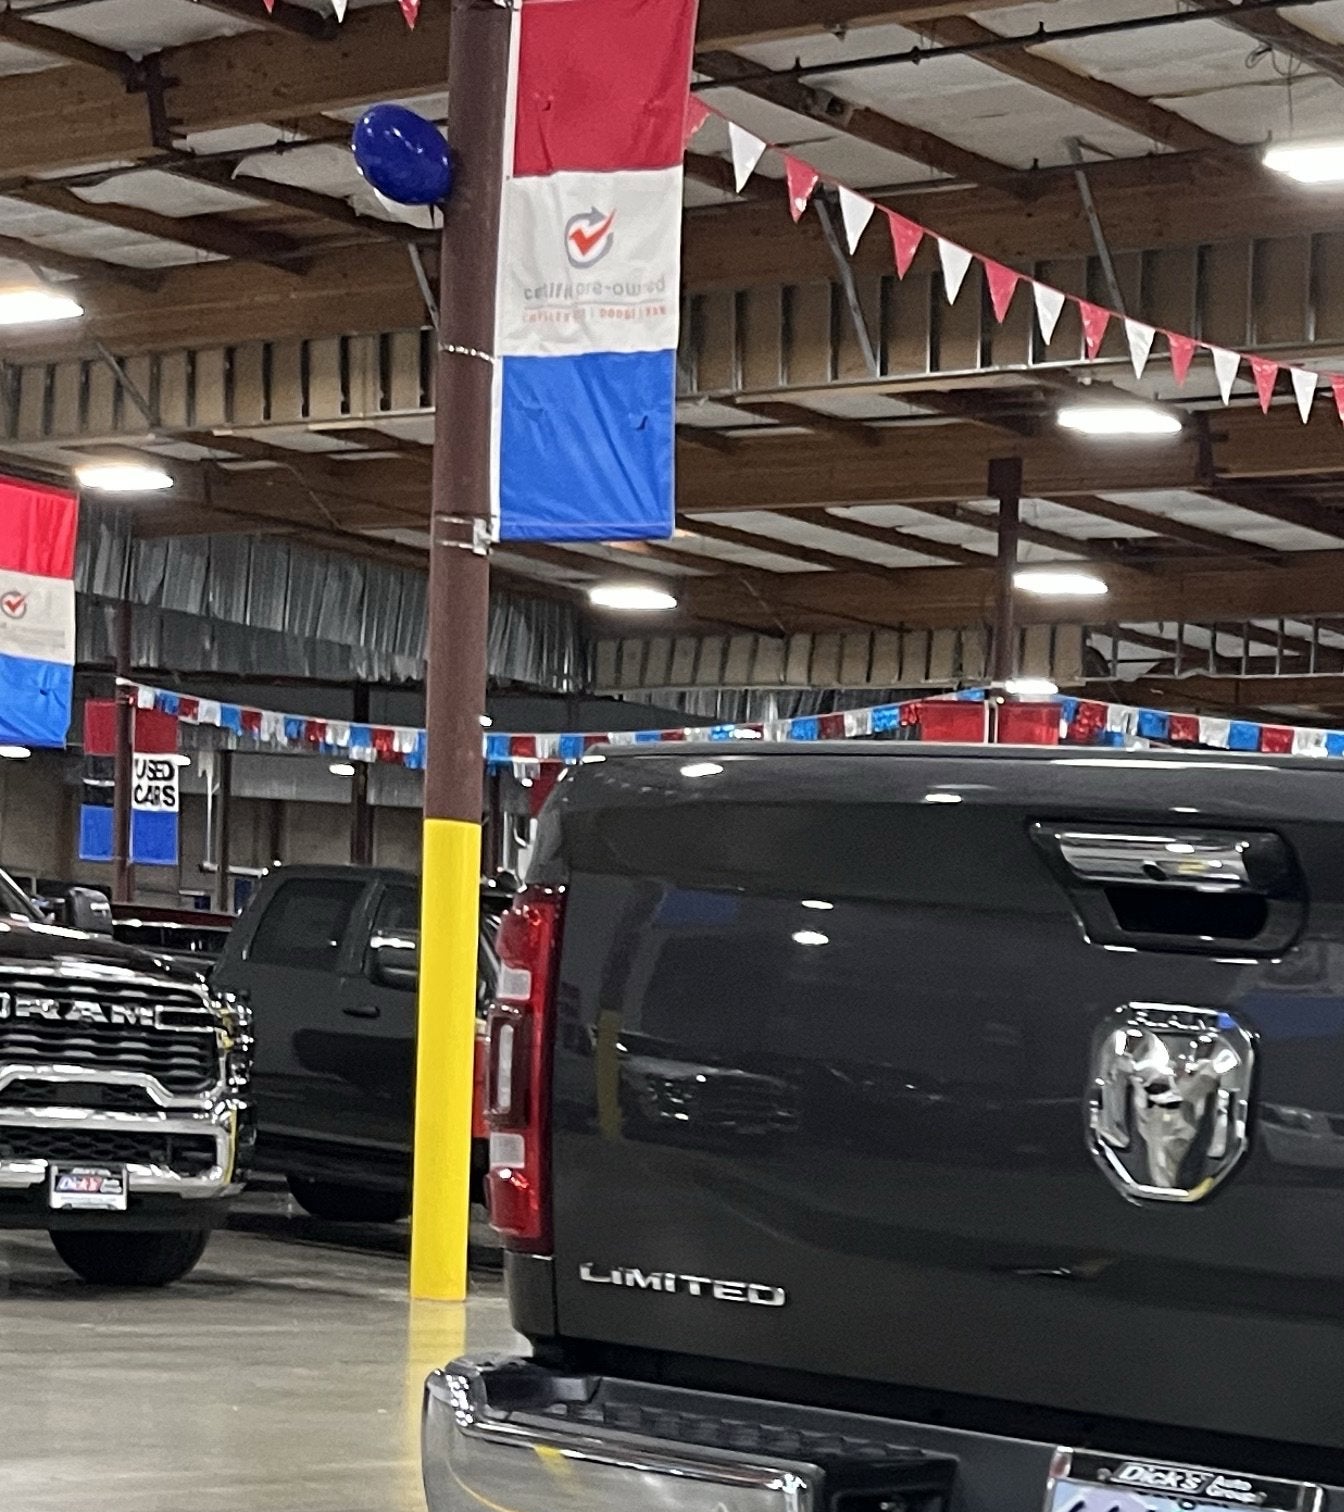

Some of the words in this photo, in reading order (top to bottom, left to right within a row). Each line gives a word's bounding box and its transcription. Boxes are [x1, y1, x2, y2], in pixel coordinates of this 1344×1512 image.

[135, 759, 175, 781] USED
[134, 784, 176, 807] CARS
[15, 997, 154, 1026] RAM
[579, 1262, 786, 1306] LIMITED
[1117, 1464, 1213, 1490] Dick's
